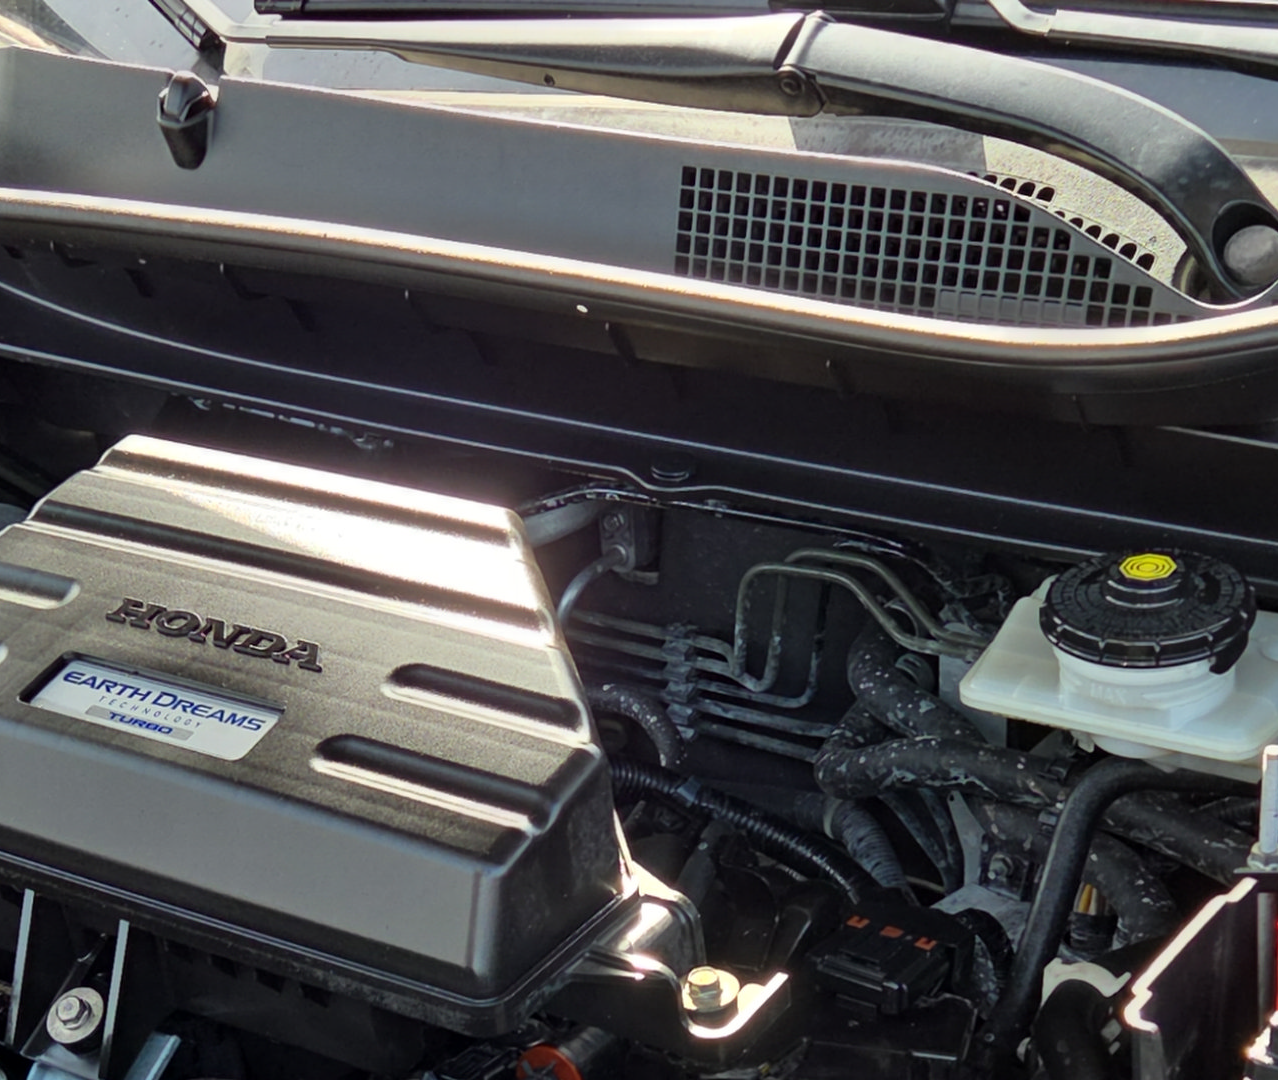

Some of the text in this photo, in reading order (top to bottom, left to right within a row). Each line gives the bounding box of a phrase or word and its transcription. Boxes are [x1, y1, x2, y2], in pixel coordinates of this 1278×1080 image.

[106, 597, 323, 673] HONDA
[62, 670, 266, 732] EARTH DREAMS
[98, 696, 202, 728] TECHNOLOGY
[108, 712, 174, 734] TURBO
